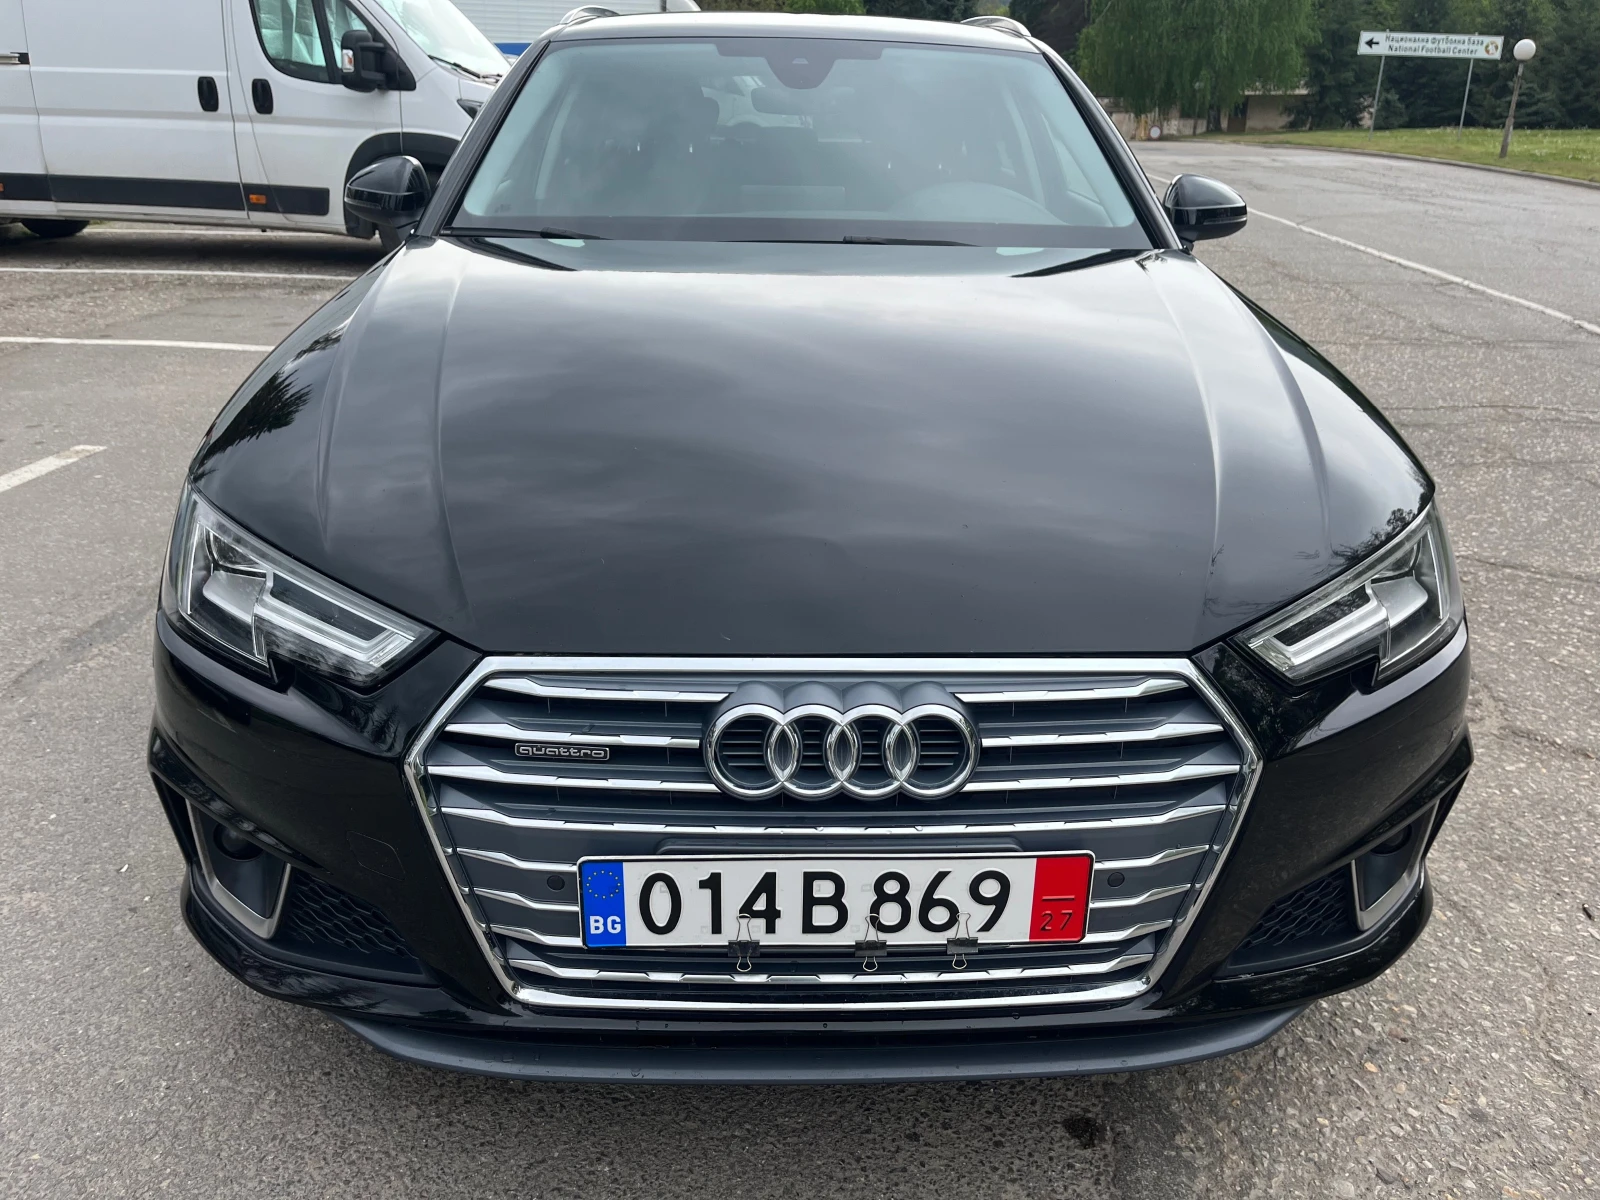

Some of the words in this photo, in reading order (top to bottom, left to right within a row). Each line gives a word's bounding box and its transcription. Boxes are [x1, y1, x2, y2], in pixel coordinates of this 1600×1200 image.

[1388, 44, 1420, 53] National
[1421, 45, 1451, 54] Football
[1452, 46, 1478, 55] Center
[519, 746, 605, 758] quattro
[589, 915, 622, 935] BG
[1041, 909, 1073, 932] 27
